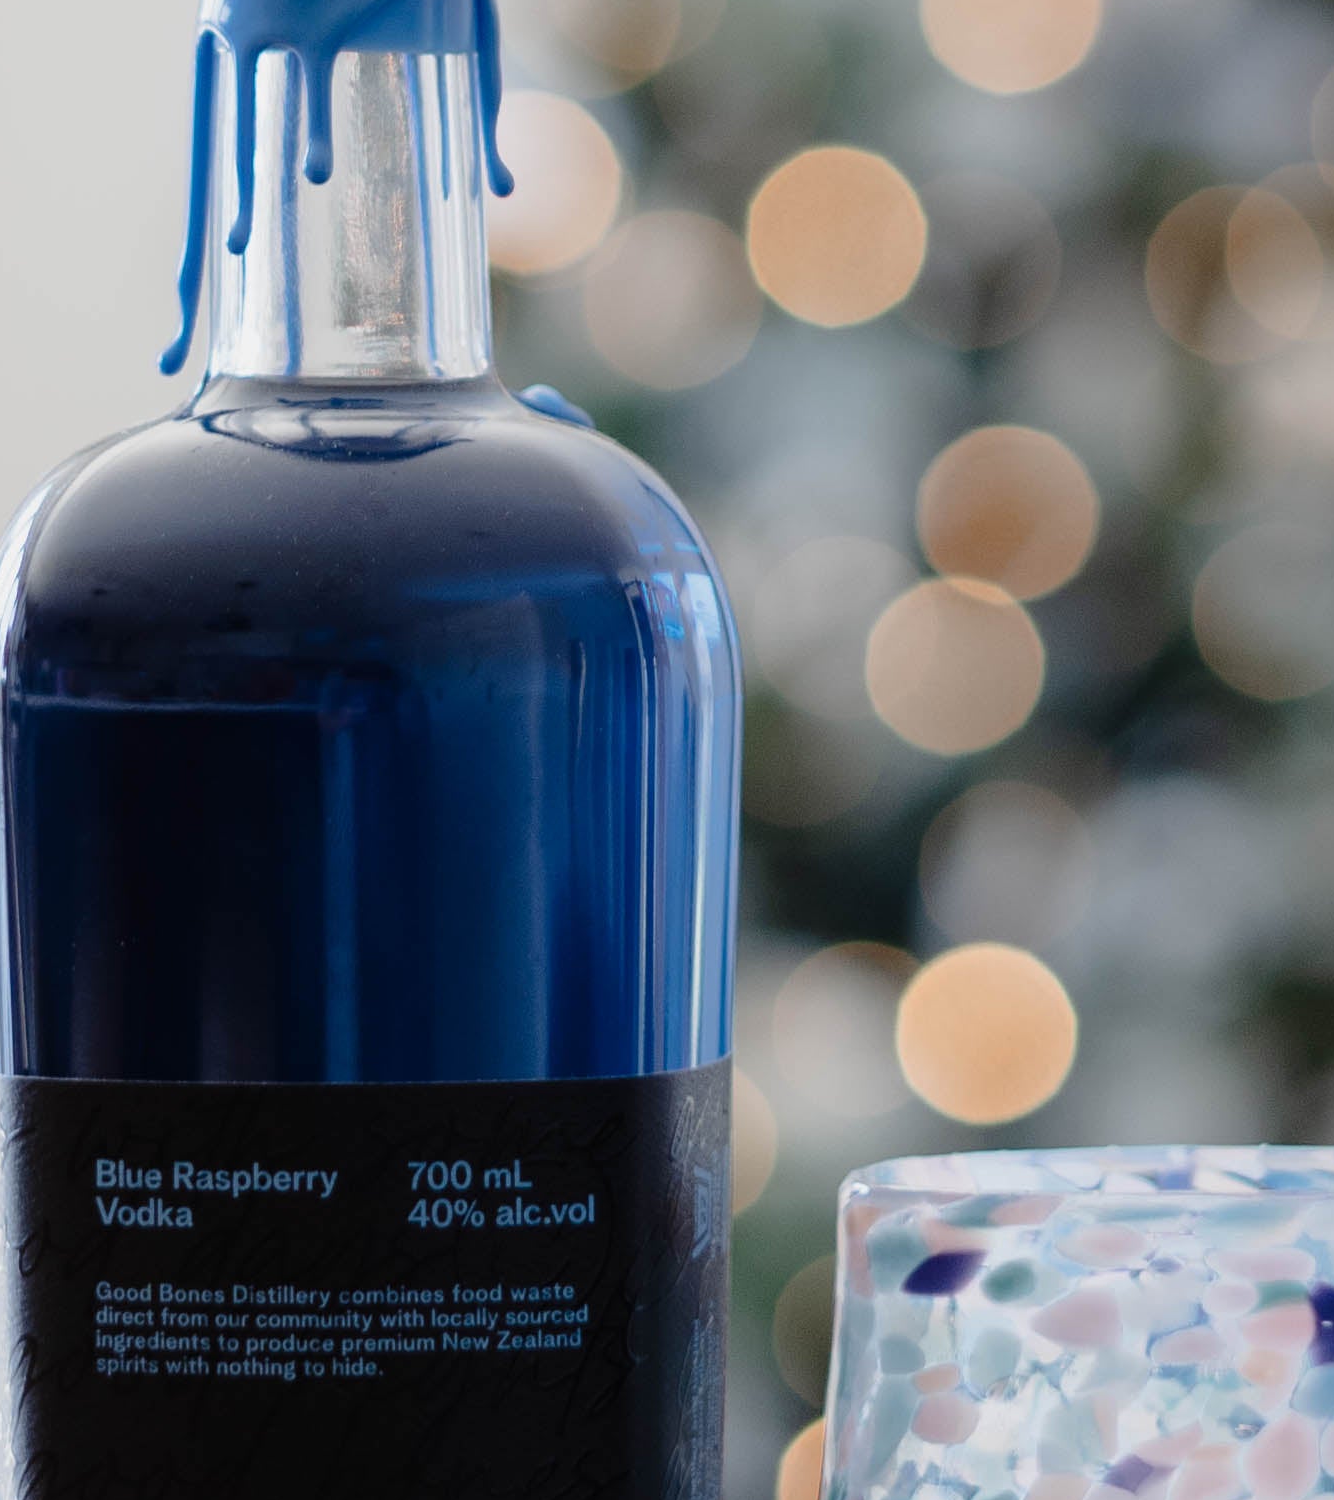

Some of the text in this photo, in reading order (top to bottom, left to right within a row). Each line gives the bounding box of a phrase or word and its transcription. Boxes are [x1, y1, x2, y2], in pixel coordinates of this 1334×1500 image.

[96, 1159, 337, 1198] Blue Raspberry
[408, 1160, 532, 1190] 700 mL
[96, 1197, 193, 1227] Vodka
[408, 1194, 594, 1228] 40% alc.vol
[96, 1281, 574, 1307] Good Bones Distillery combines food waste
[96, 1304, 588, 1331] direct from our community with locally sourced
[96, 1328, 581, 1355] ingredients to produce premium New Zealand
[97, 1355, 382, 1380] spirits with nothing to hide.
